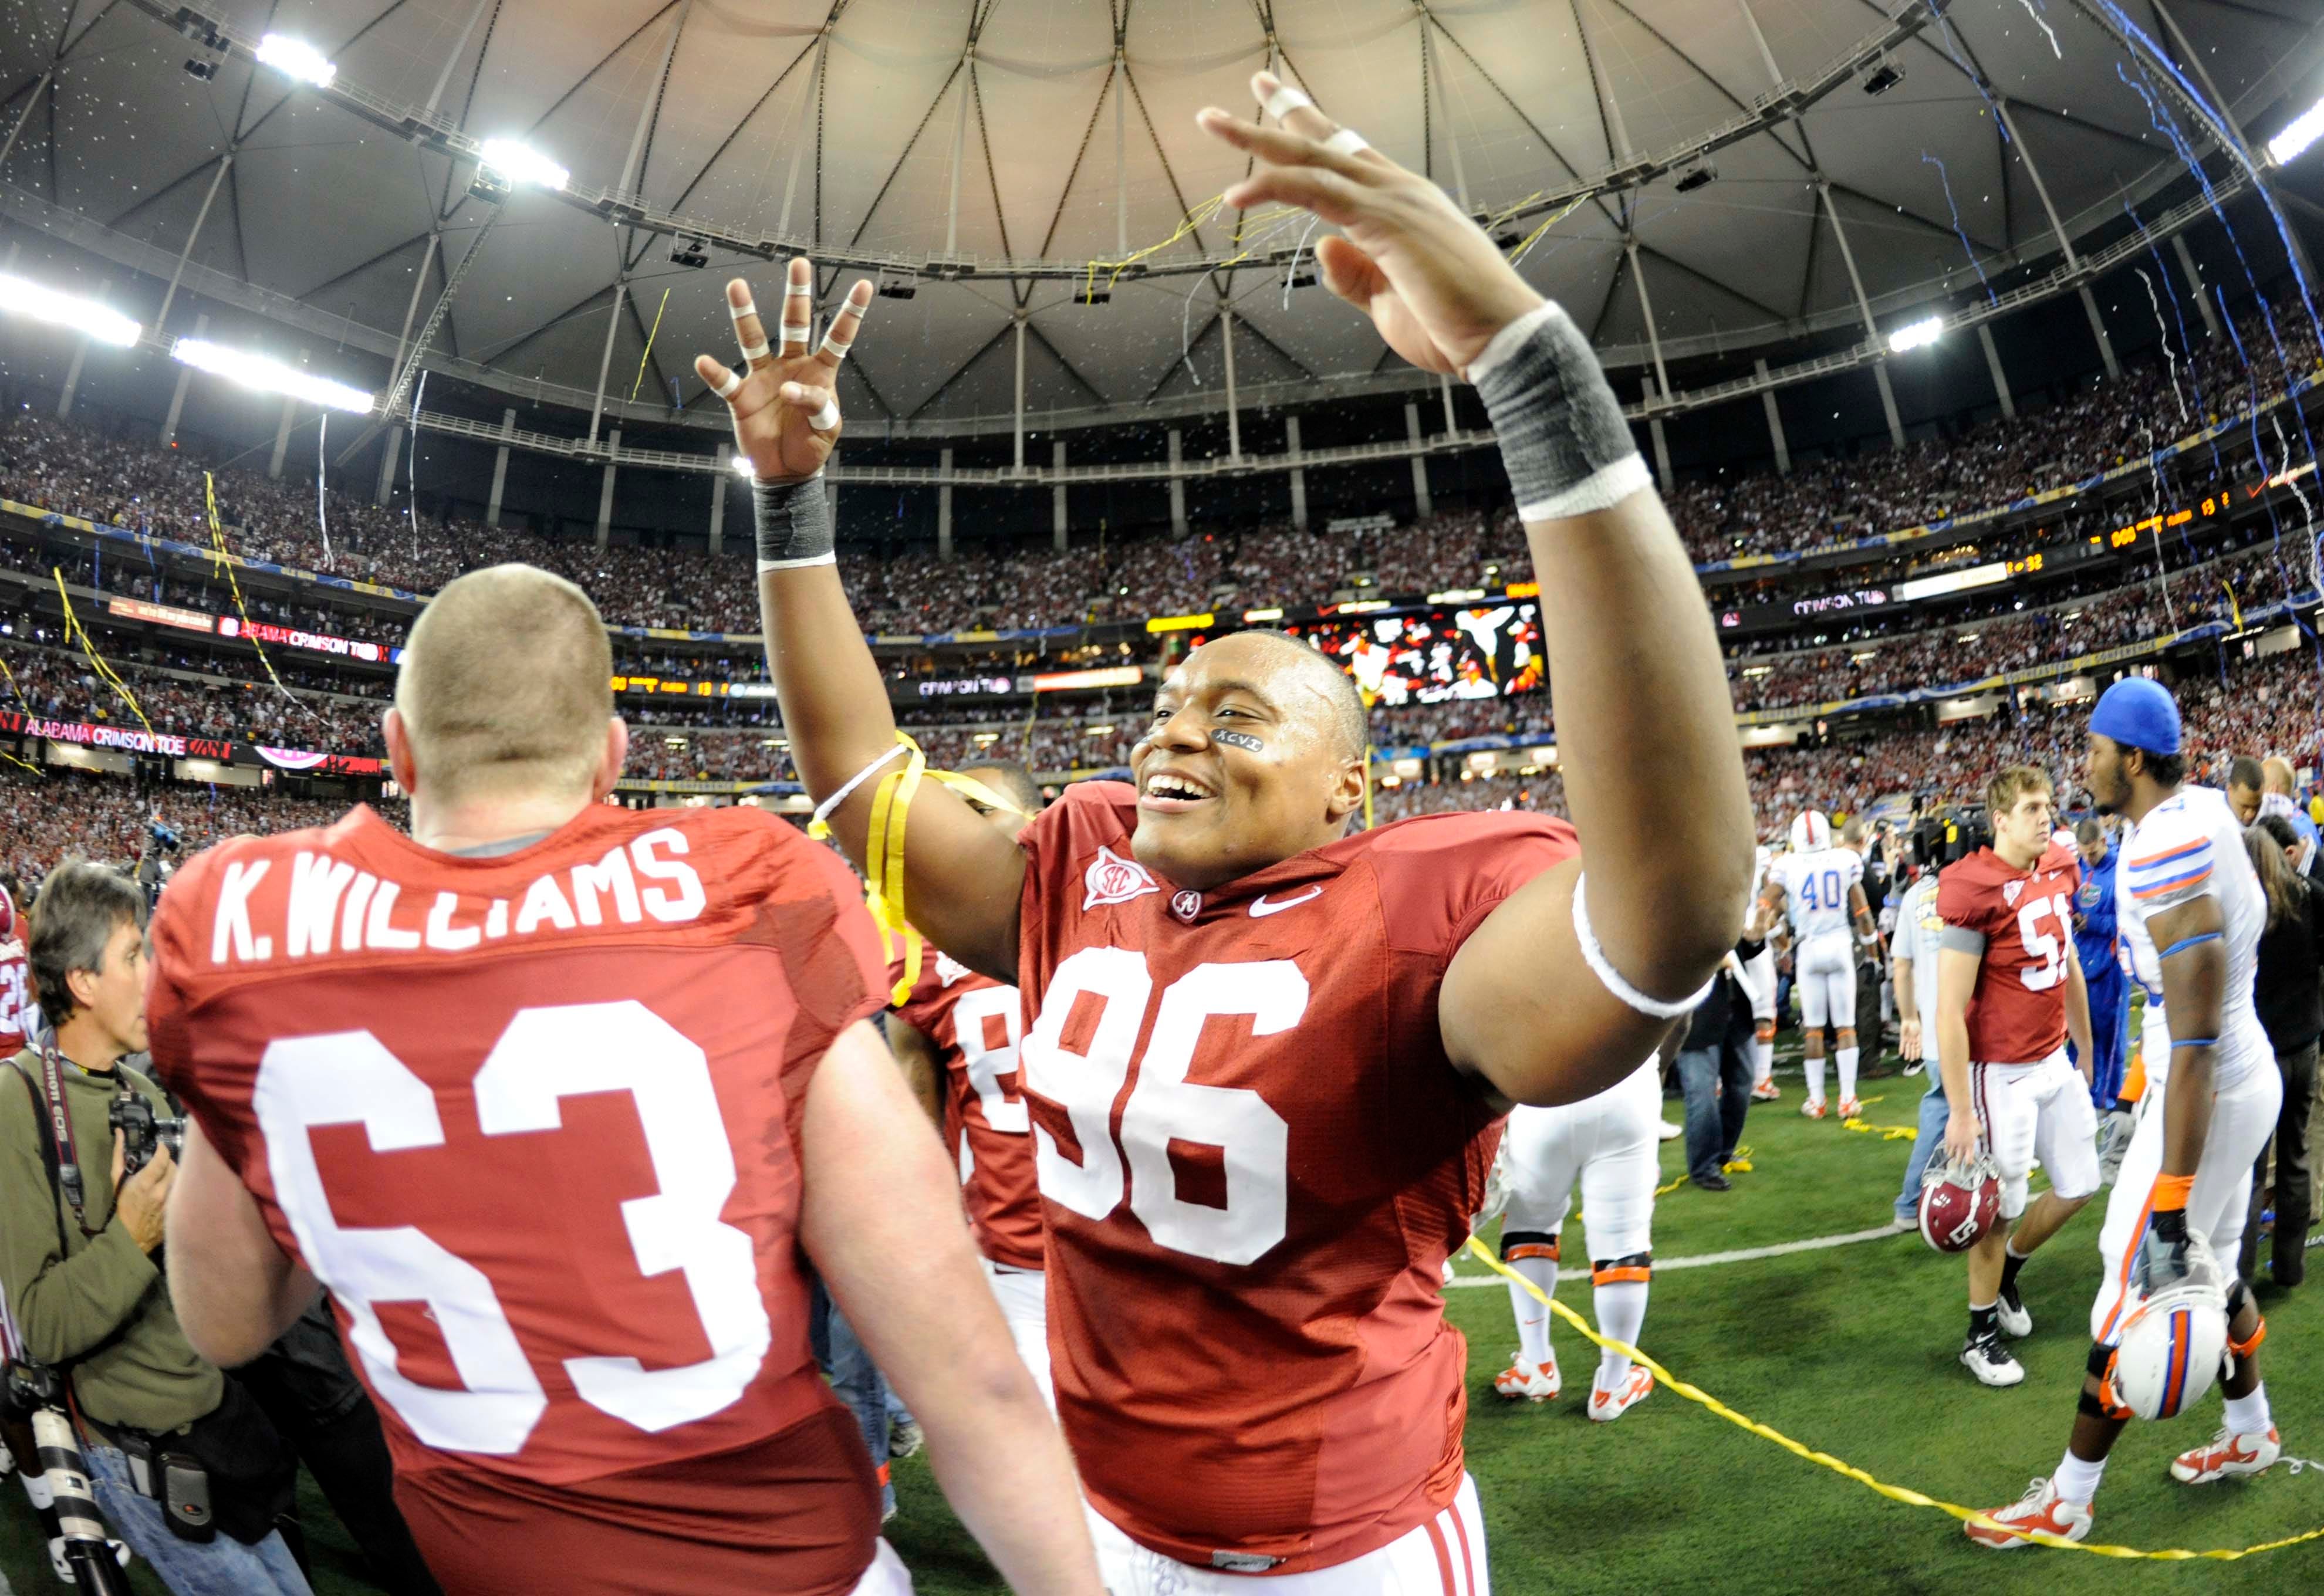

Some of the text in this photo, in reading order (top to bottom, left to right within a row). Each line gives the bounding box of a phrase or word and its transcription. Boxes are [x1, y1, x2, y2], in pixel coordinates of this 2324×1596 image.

[134, 534, 161, 547] LU
[289, 631, 349, 655] CRIMSON
[25, 719, 90, 743] ALABAMA
[93, 727, 154, 753] CRIMSON
[1215, 729, 1262, 752] XCVI
[211, 827, 706, 963] K. WILLIAMS
[1801, 870, 1841, 911] 40
[2018, 892, 2072, 992] 51
[45, 1047, 69, 1142] Canon EOS
[1021, 945, 1310, 1266] 96
[252, 999, 772, 1455] 63
